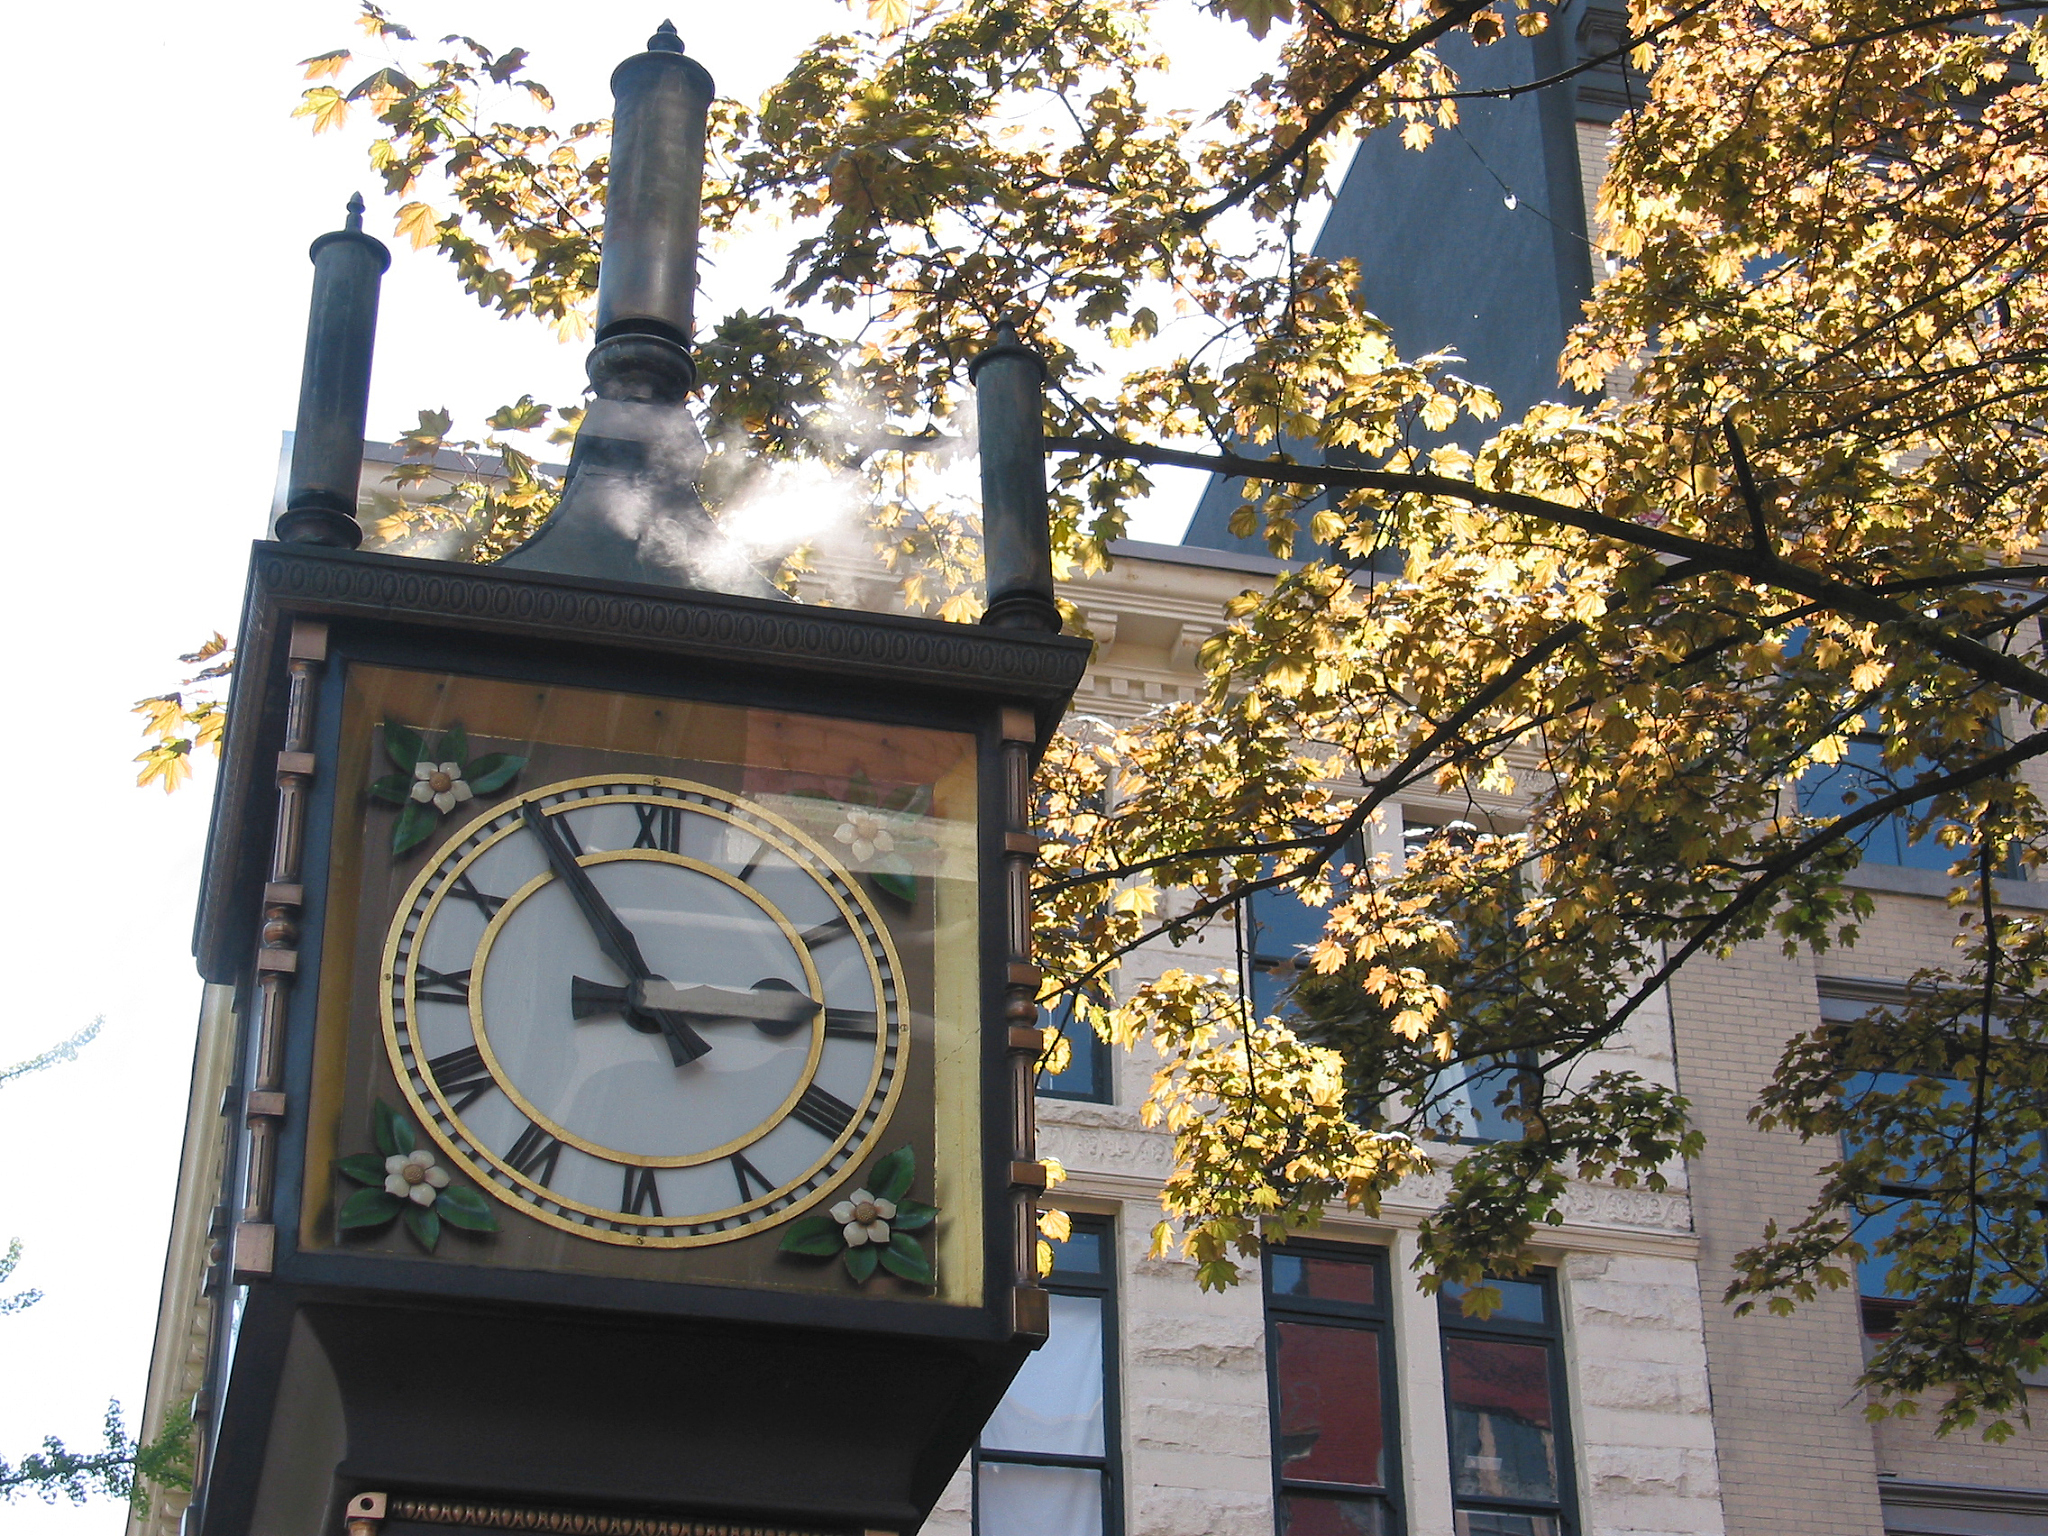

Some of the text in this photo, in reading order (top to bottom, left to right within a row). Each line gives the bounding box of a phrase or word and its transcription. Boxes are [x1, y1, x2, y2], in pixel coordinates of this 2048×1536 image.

[633, 803, 681, 854] XII
[446, 872, 508, 923] X
[799, 914, 852, 951] II
[415, 963, 472, 1006] IX
[826, 1008, 877, 1042] III
[427, 1045, 497, 1110] VIII
[503, 1122, 562, 1188] VII
[730, 1152, 778, 1203] V
[621, 1166, 663, 1217] VI
